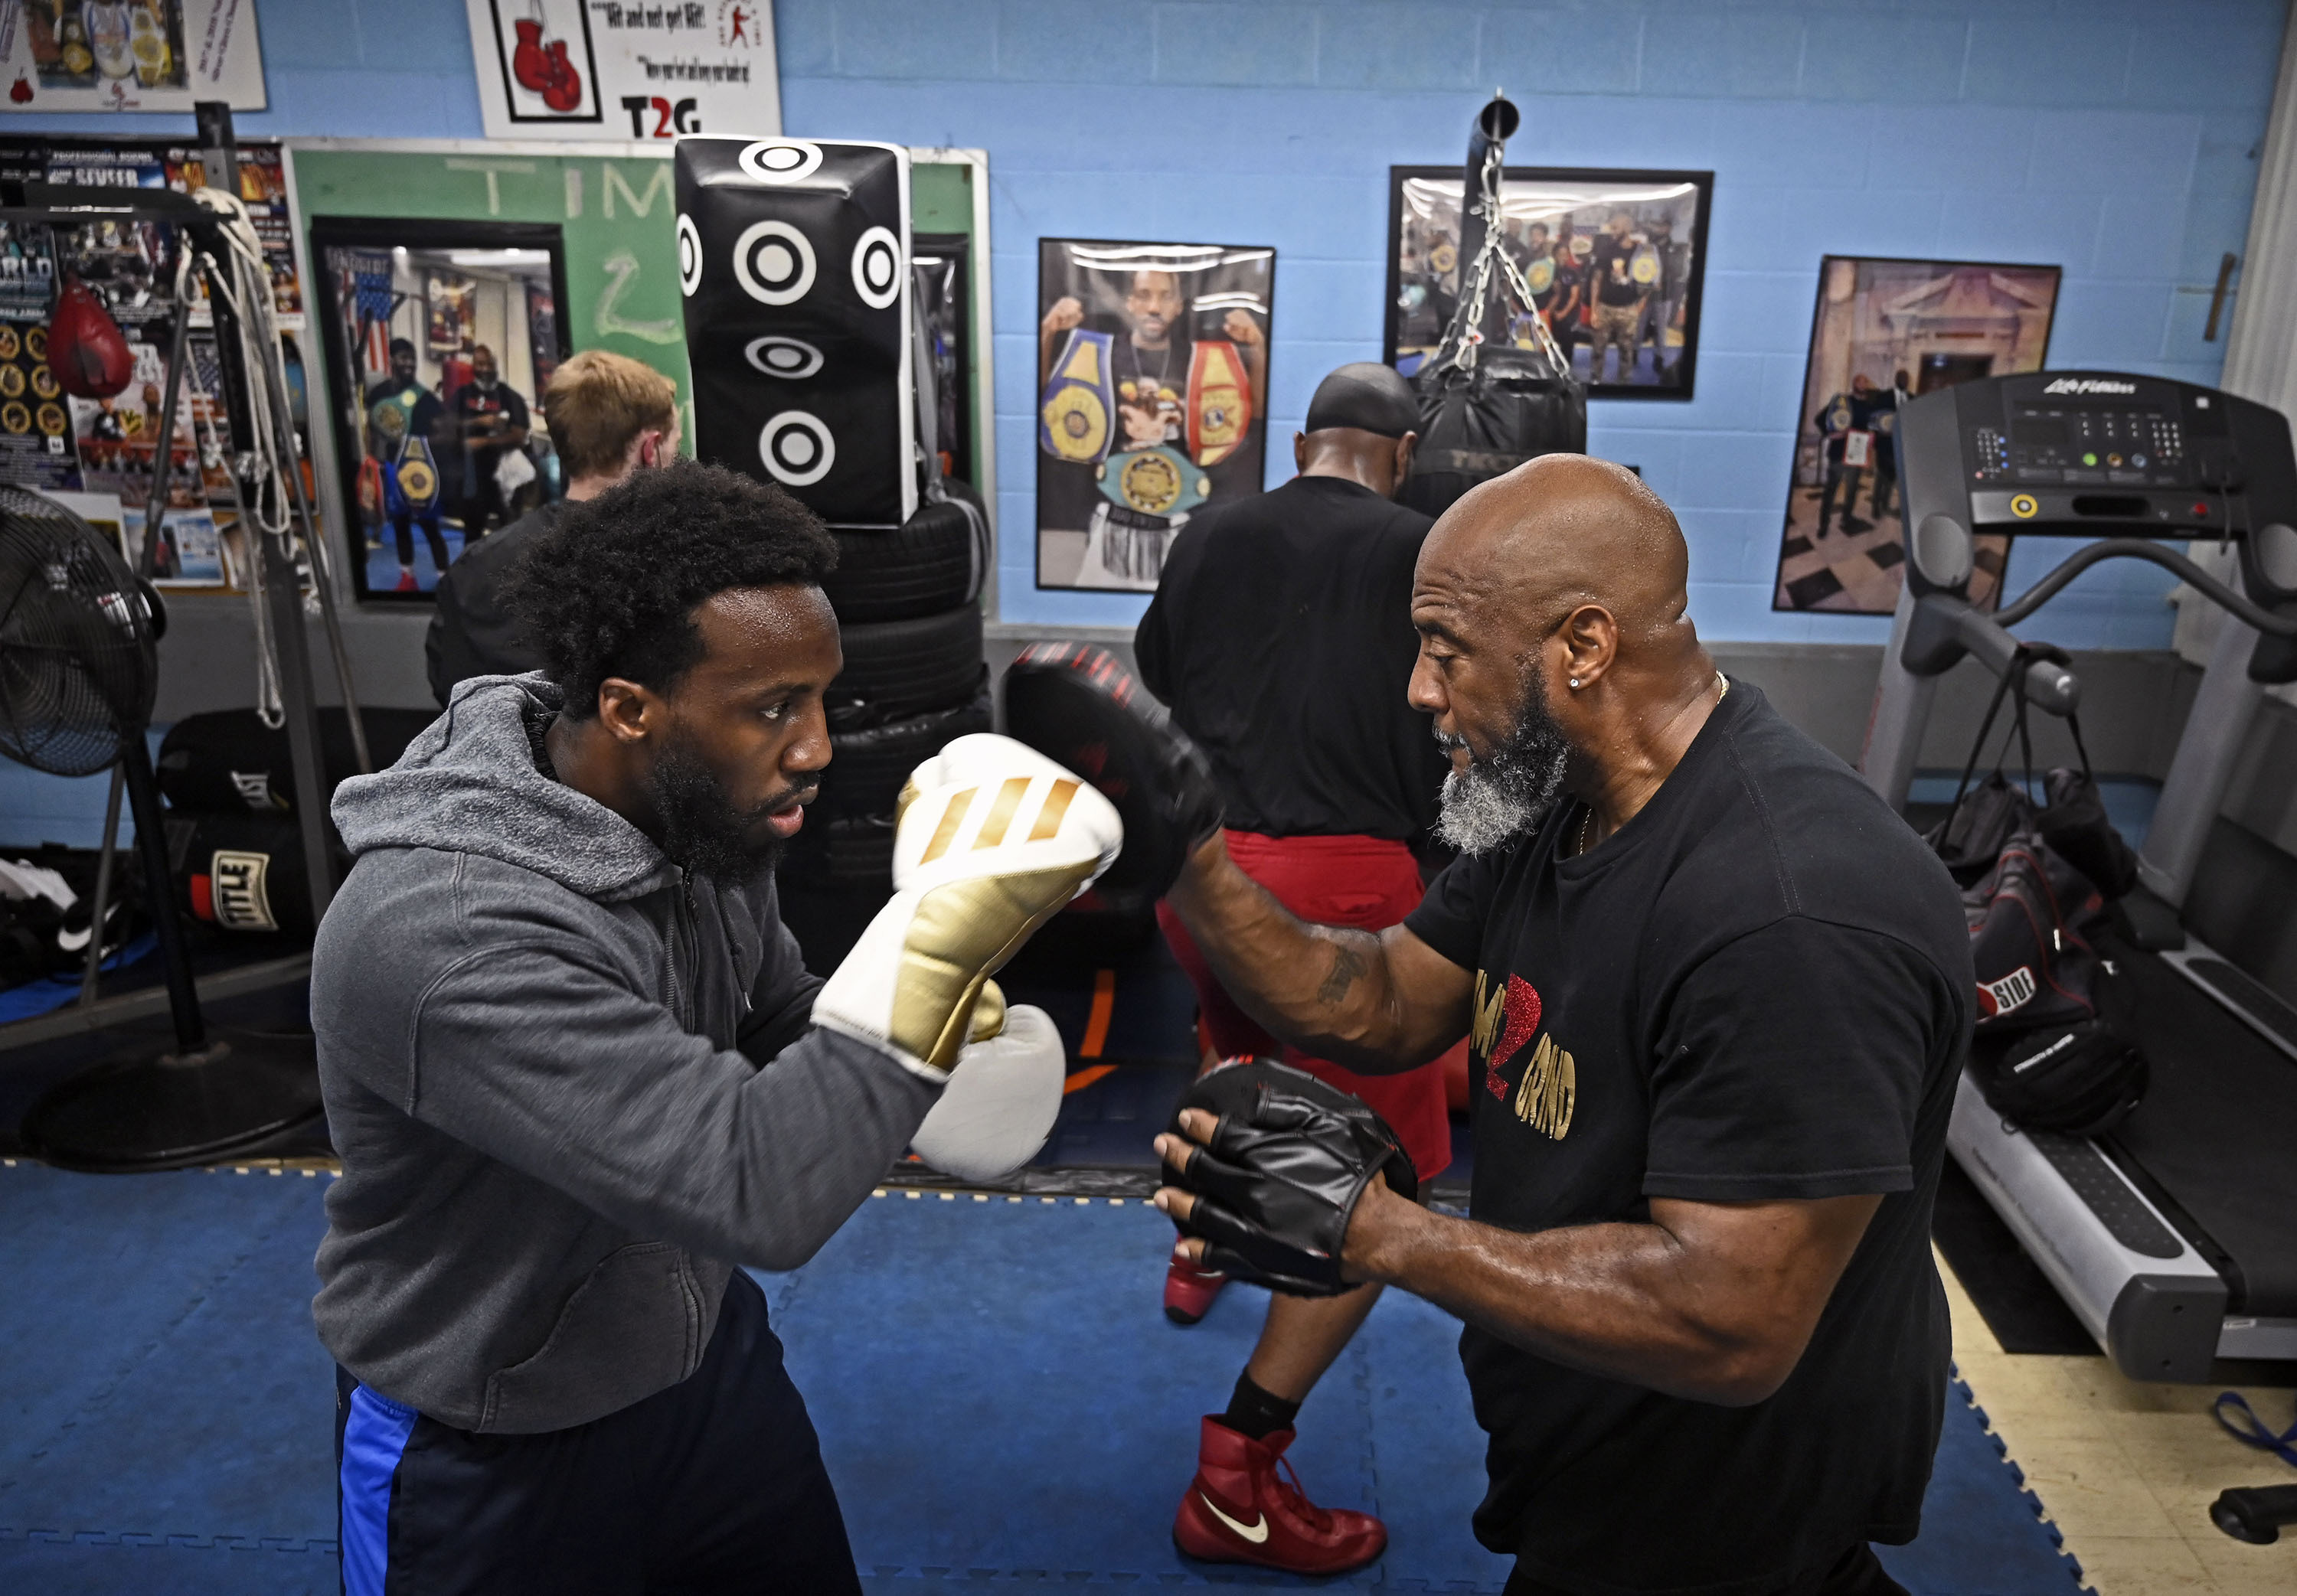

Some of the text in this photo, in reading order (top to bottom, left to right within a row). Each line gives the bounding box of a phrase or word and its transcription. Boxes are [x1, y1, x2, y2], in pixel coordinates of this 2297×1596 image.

[621, 96, 701, 138] T2G
[595, 250, 684, 345] 2
[221, 863, 256, 924] TITLE
[1993, 970, 2034, 1009] SIDE
